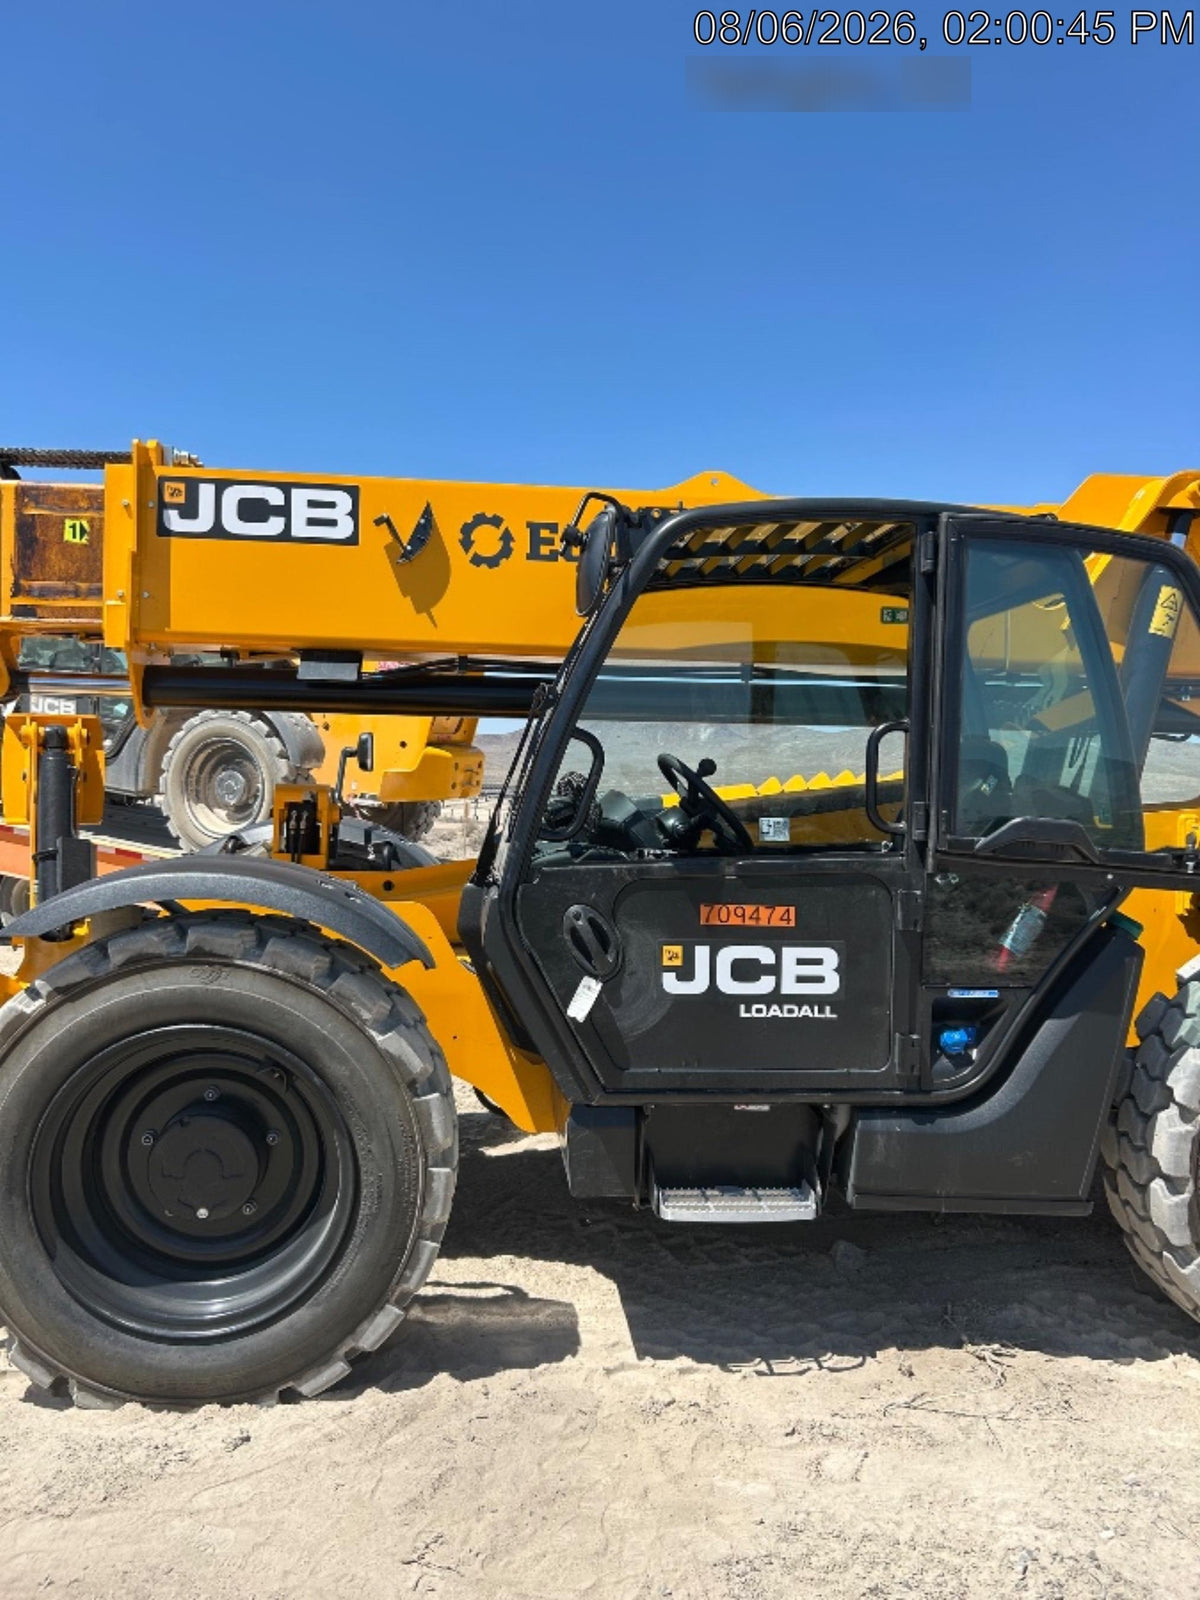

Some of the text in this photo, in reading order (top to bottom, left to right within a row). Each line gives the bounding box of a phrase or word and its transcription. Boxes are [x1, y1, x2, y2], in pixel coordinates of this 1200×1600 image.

[163, 482, 355, 539] JCB
[702, 904, 793, 925] 709474
[662, 945, 840, 994] JCB
[739, 1003, 838, 1019] LOADALL
